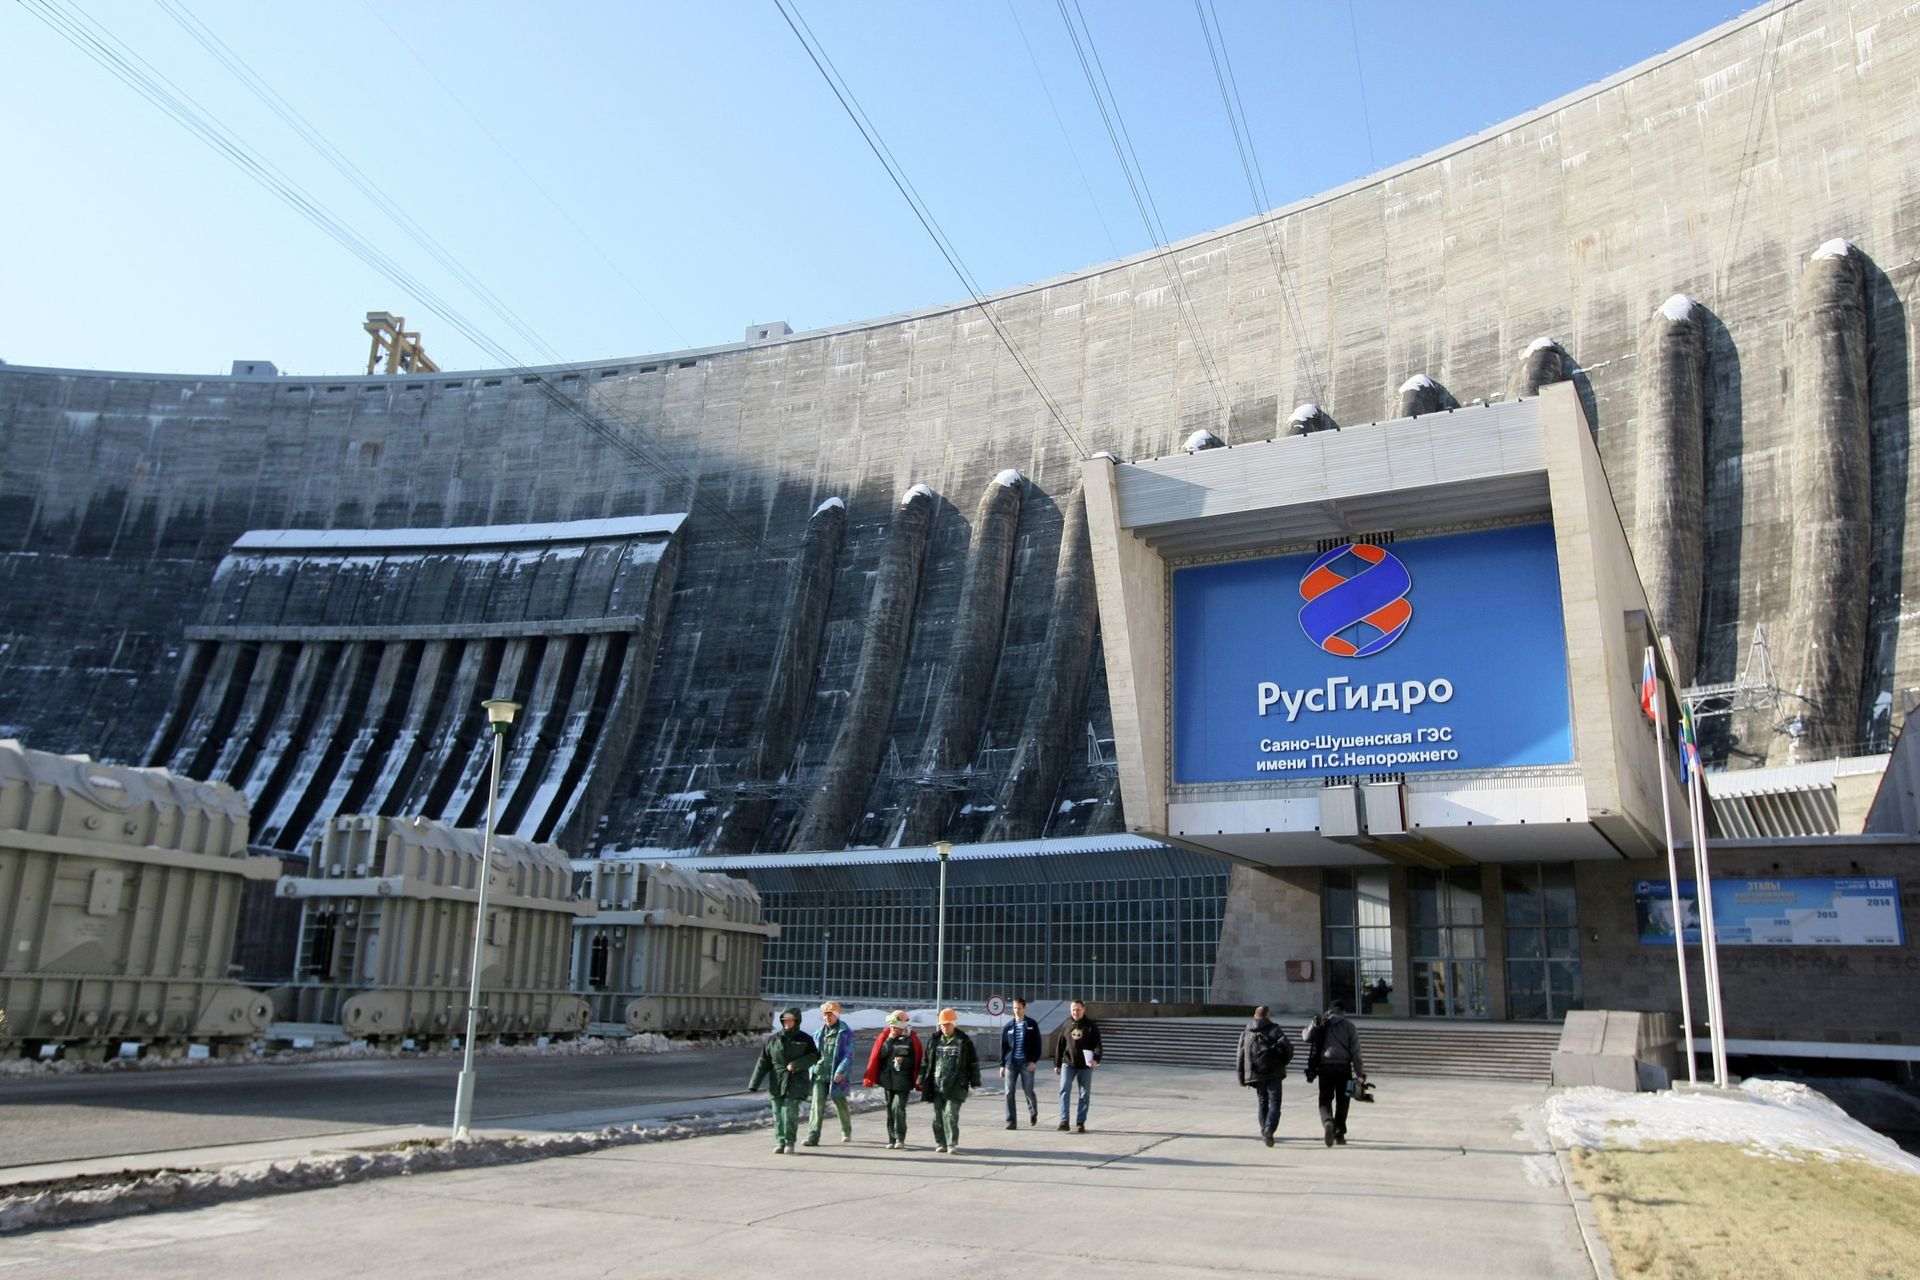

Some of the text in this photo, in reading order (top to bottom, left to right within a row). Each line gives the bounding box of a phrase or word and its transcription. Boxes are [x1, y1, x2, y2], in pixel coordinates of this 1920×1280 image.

[1258, 676, 1454, 722] РусГидро
[1260, 726, 1453, 753] Саяно-Шушенская ГЭС
[1256, 749, 1459, 771] имени П.С.Непорожнего
[1866, 898, 1891, 907] 2014
[993, 1001, 999, 1010] 5
